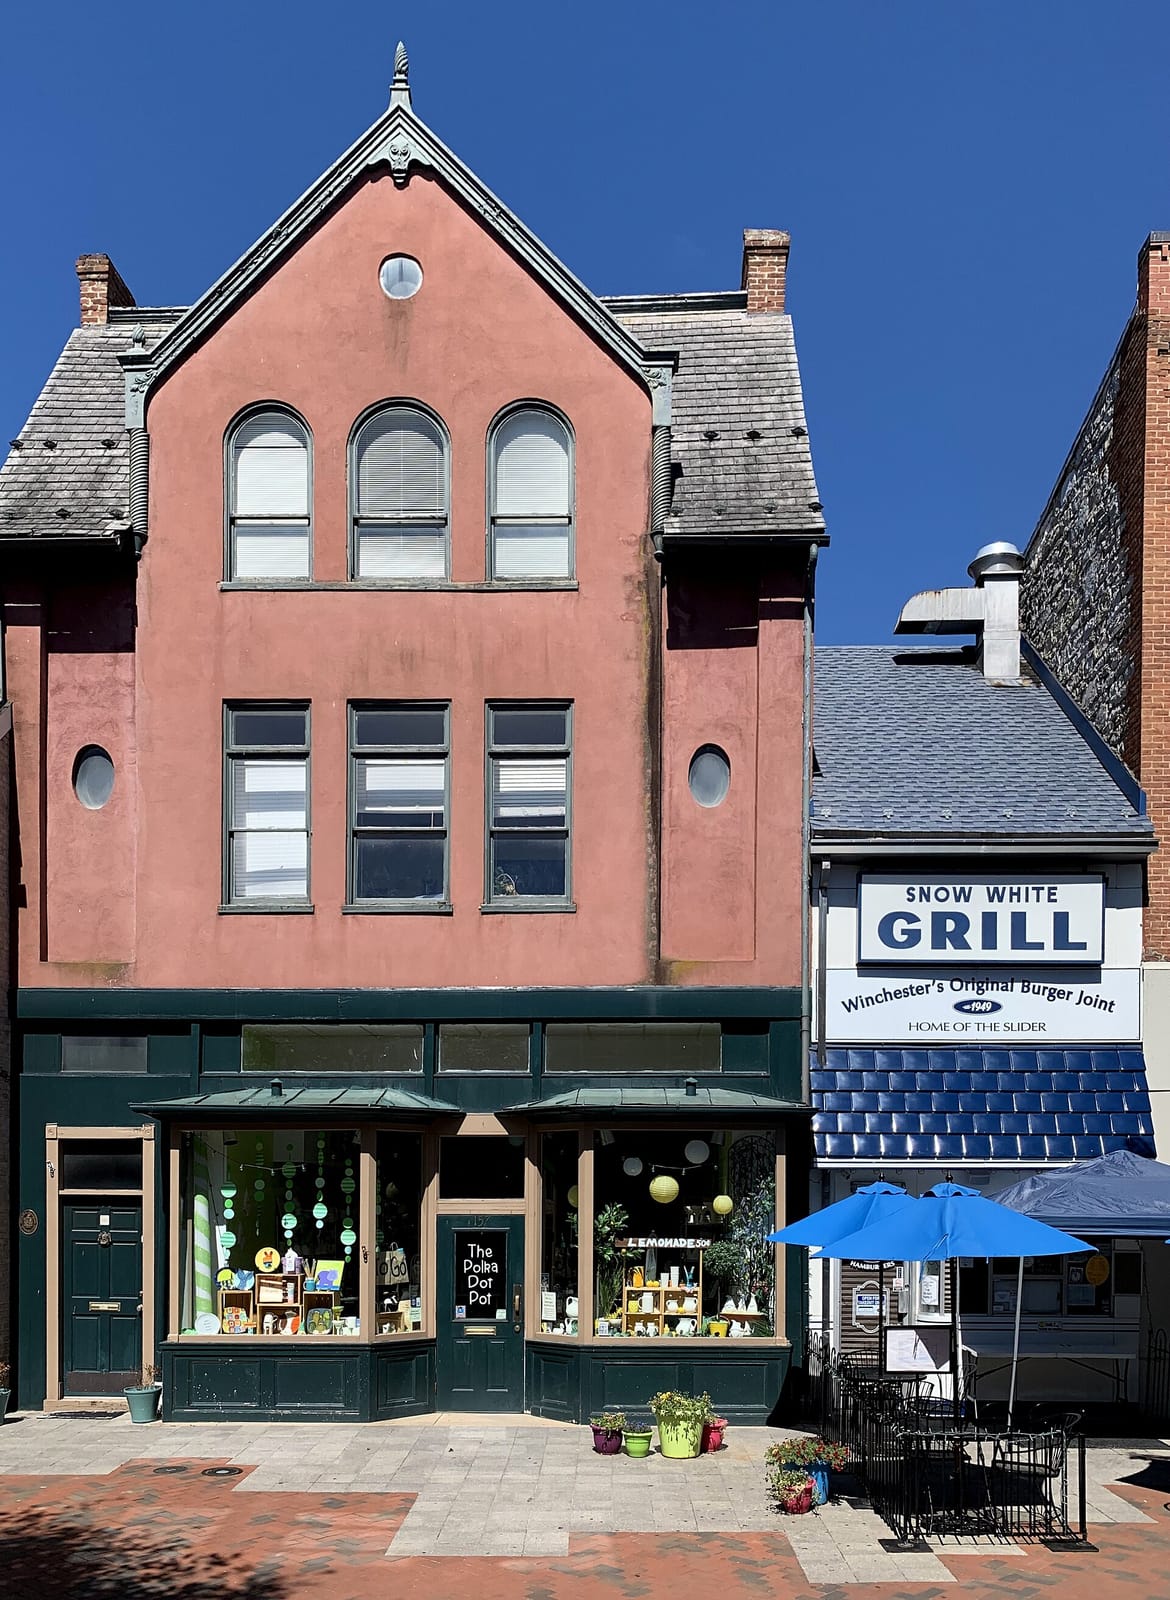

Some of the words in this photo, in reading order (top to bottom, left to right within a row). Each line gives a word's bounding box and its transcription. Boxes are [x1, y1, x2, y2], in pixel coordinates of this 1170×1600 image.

[906, 886, 973, 903] SNOW
[986, 886, 1058, 903] WHITE
[877, 911, 1087, 950] GRILL
[841, 979, 944, 1014] Winchester's
[950, 977, 1014, 996] Original
[1021, 979, 1073, 1002] Burger
[1075, 990, 1116, 1014] Joint
[971, 1001, 992, 1011] 1949
[908, 1022, 951, 1032] HOME
[953, 1022, 972, 1032] OF
[974, 1022, 1000, 1032] THE
[1002, 1022, 1047, 1032] SLIDER
[467, 1243, 493, 1258] The
[627, 1238, 695, 1248] LEMONADE
[391, 1256, 407, 1277] Go
[463, 1259, 498, 1274] Polka
[850, 1260, 895, 1270] HAMBURERS
[467, 1275, 493, 1289] Dot
[469, 1290, 492, 1305] Pot
